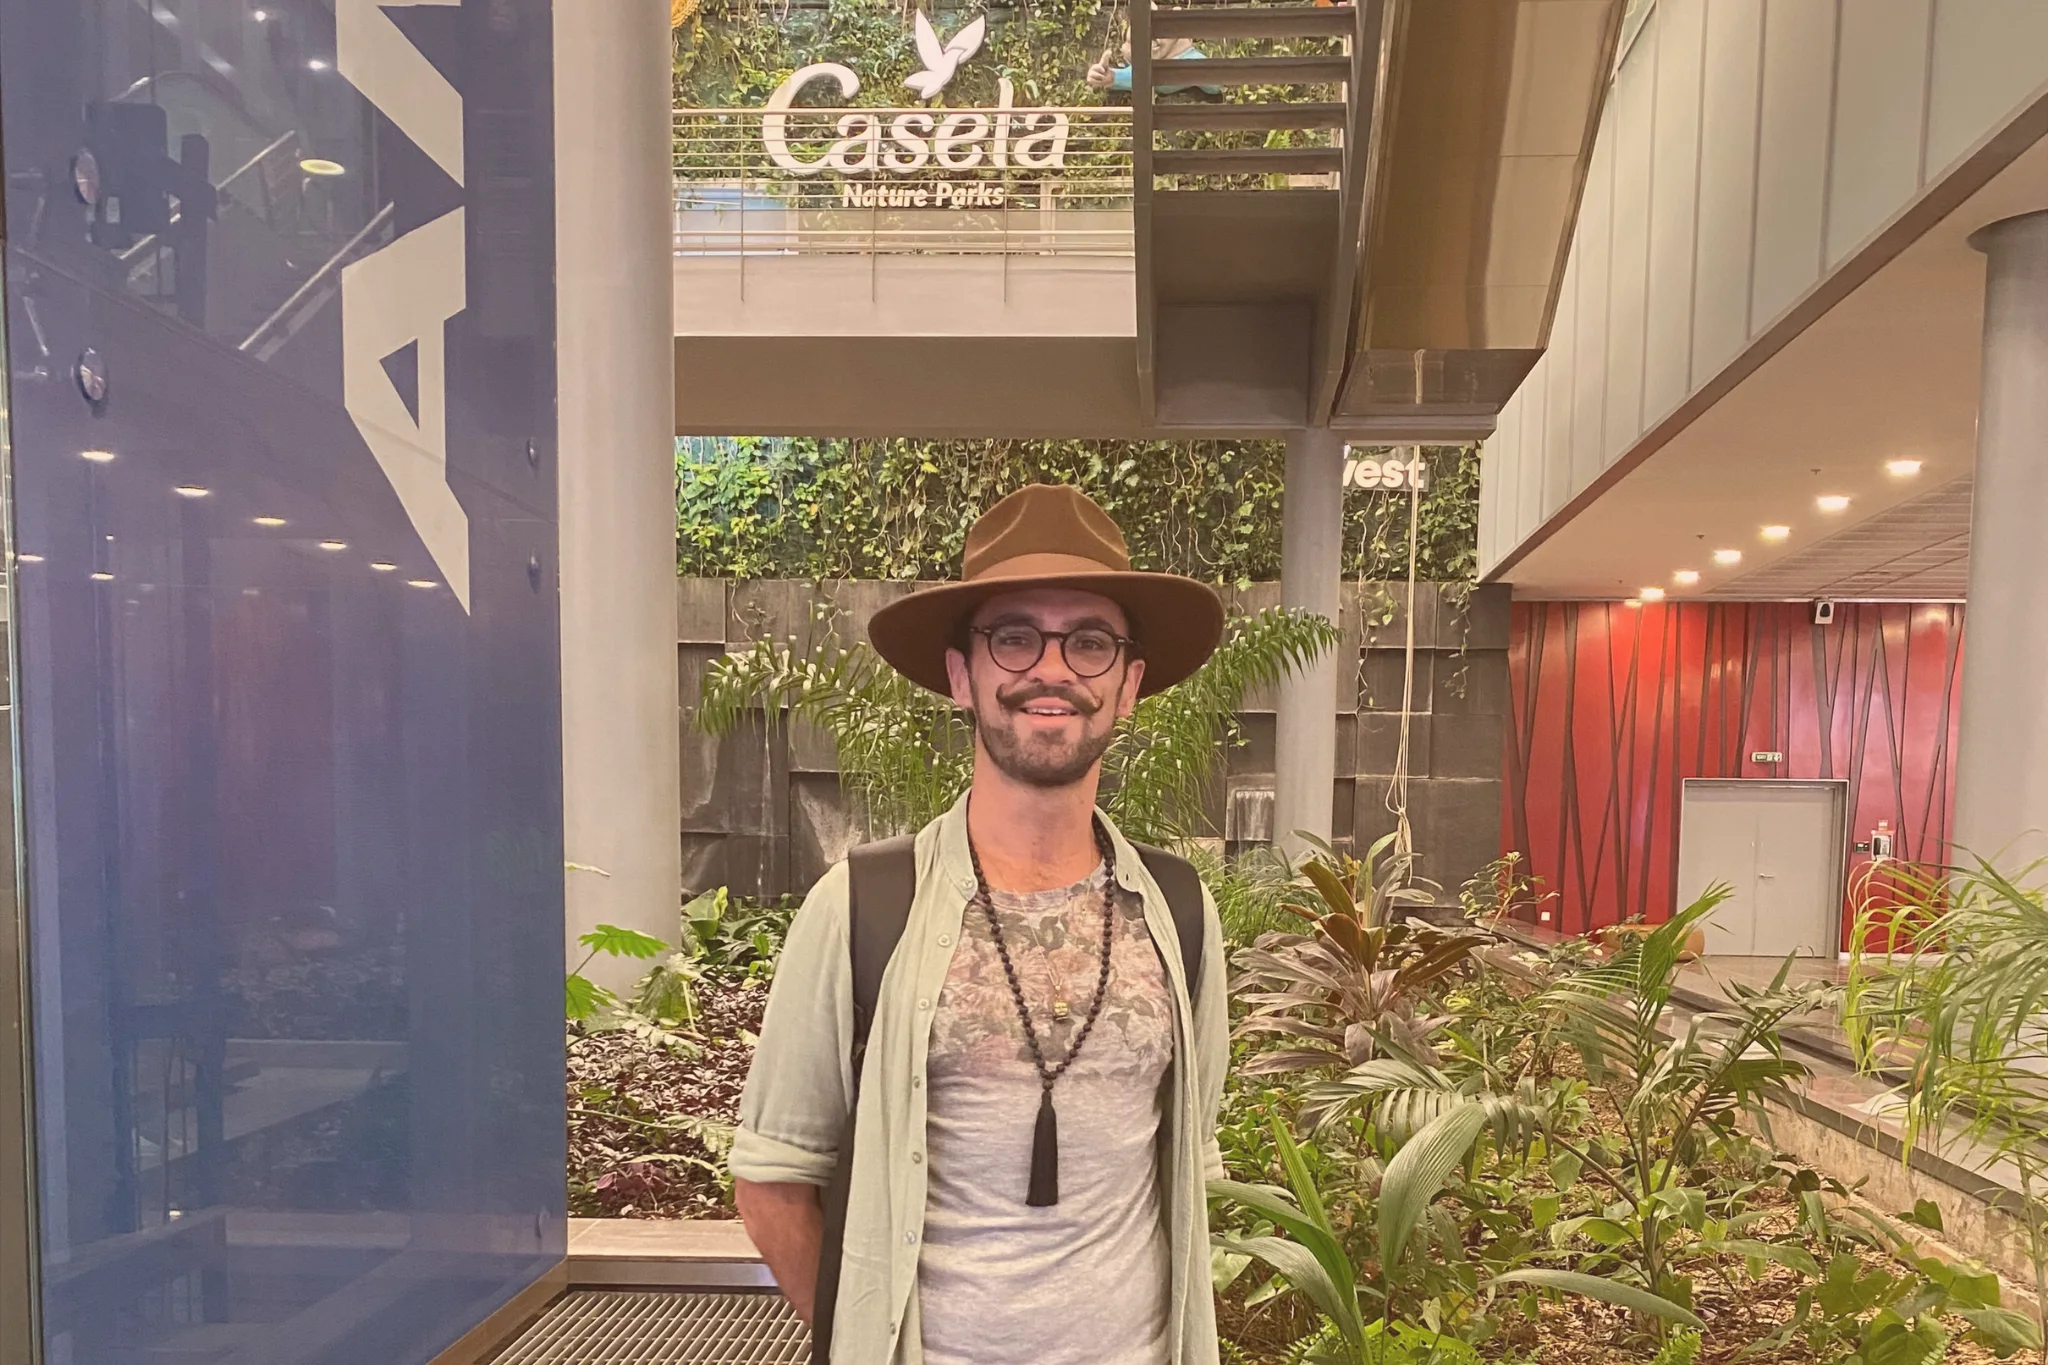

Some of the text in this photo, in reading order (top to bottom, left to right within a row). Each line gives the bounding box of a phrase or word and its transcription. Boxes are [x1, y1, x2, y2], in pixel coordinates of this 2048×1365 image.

[763, 62, 1070, 174] Casela
[842, 182, 1004, 208] Nature Parks
